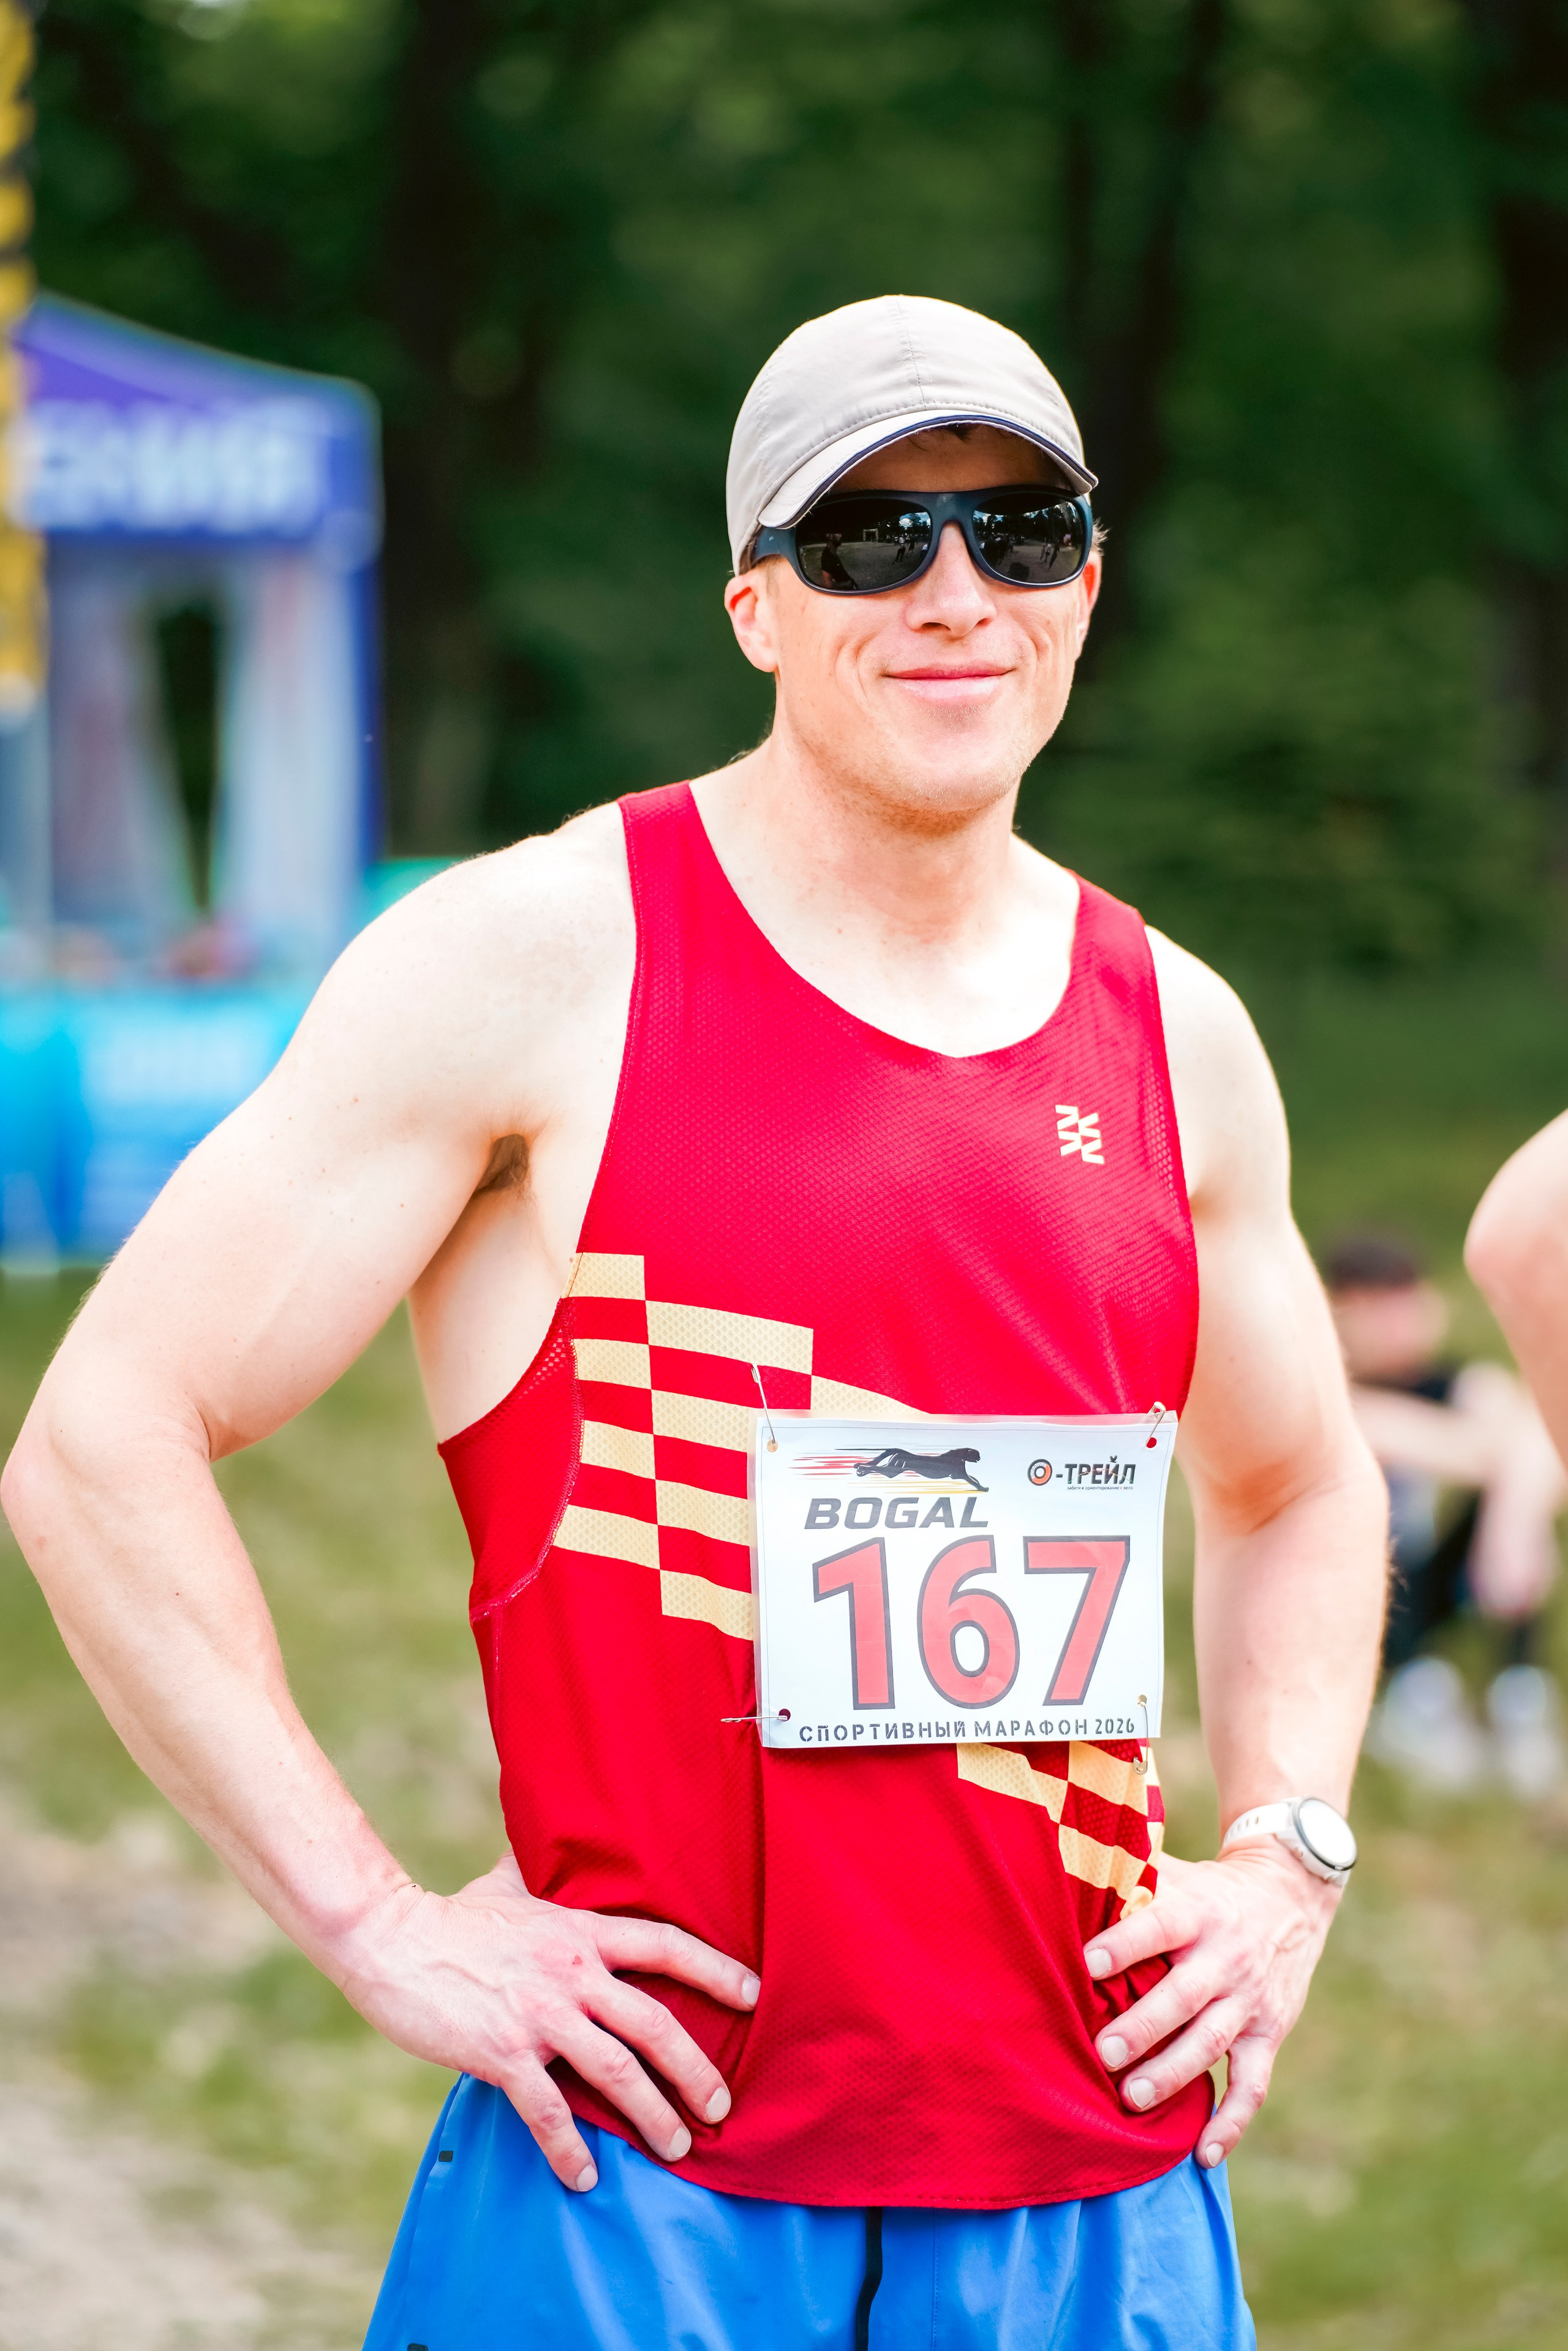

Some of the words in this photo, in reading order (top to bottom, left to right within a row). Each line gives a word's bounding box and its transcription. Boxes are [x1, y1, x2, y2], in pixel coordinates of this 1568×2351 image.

[804, 1496, 989, 1530] BOGAL
[812, 1534, 1131, 1710] 167
[799, 1720, 966, 1742] СПОРТИВНЫЙ
[974, 1719, 1087, 1737] МАРАФОН
[1095, 1718, 1134, 1734] 2026
